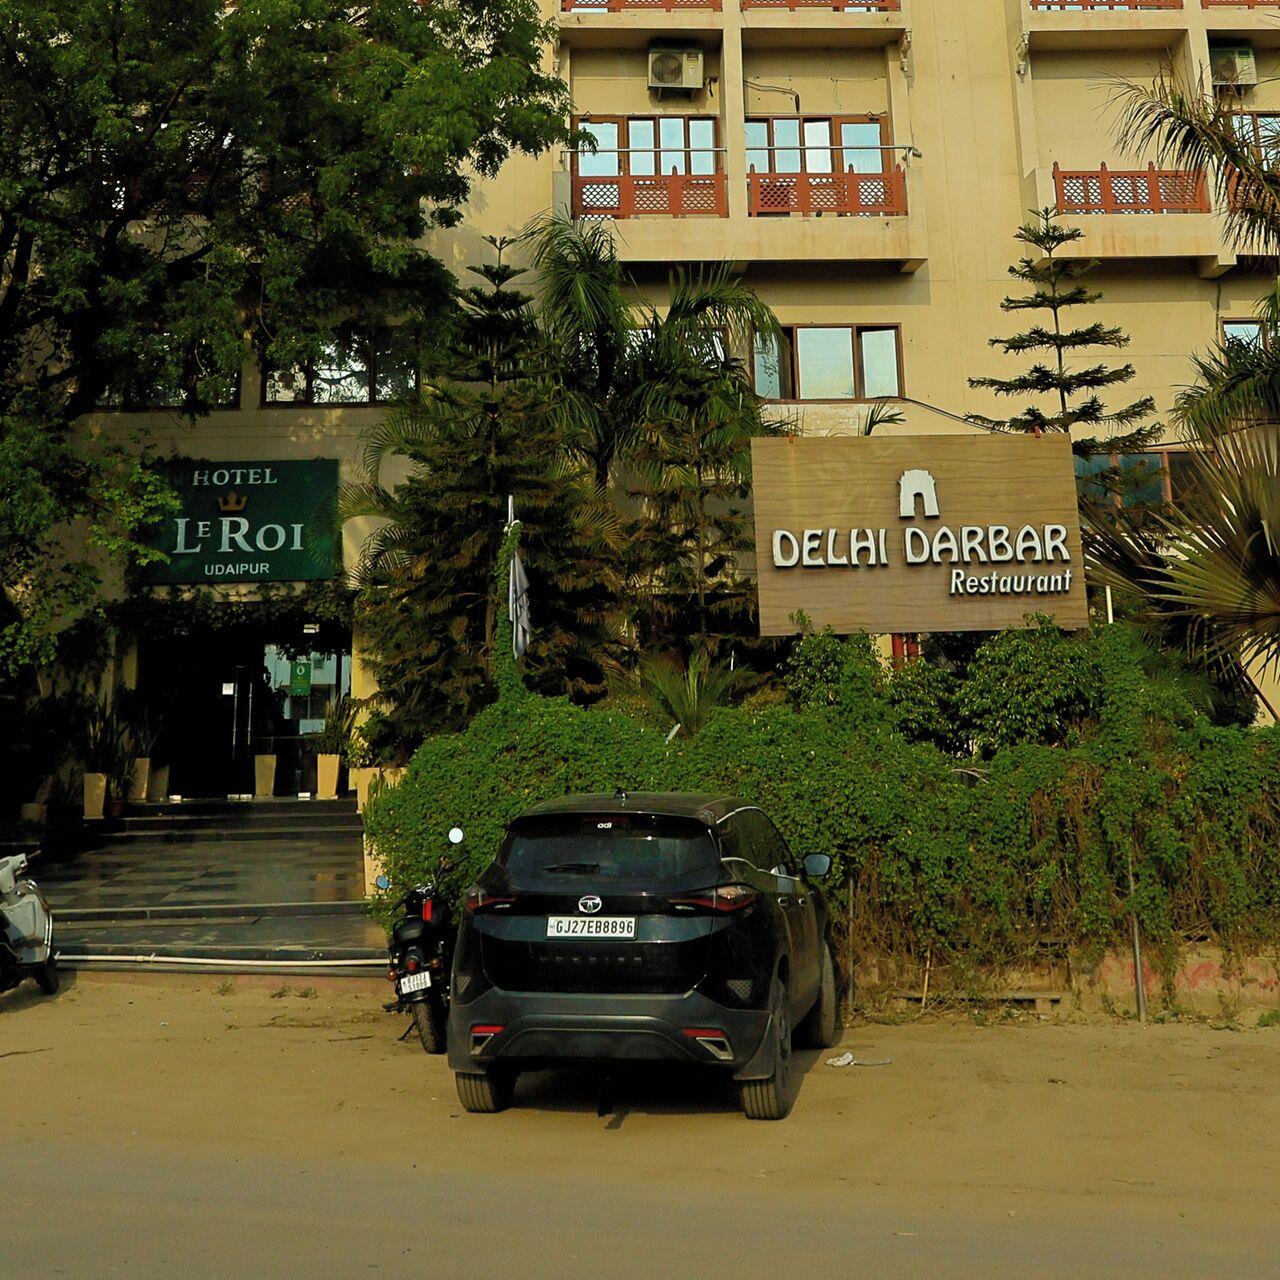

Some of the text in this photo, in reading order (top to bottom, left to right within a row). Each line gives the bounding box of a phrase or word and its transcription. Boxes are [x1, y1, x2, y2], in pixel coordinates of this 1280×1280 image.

[192, 469, 278, 486] HOTEL
[772, 524, 1072, 568] DELHI DARBAR
[204, 563, 270, 576] UDAIPUR
[949, 569, 1073, 595] Restaurant
[556, 920, 634, 934] GJ27EB8896
